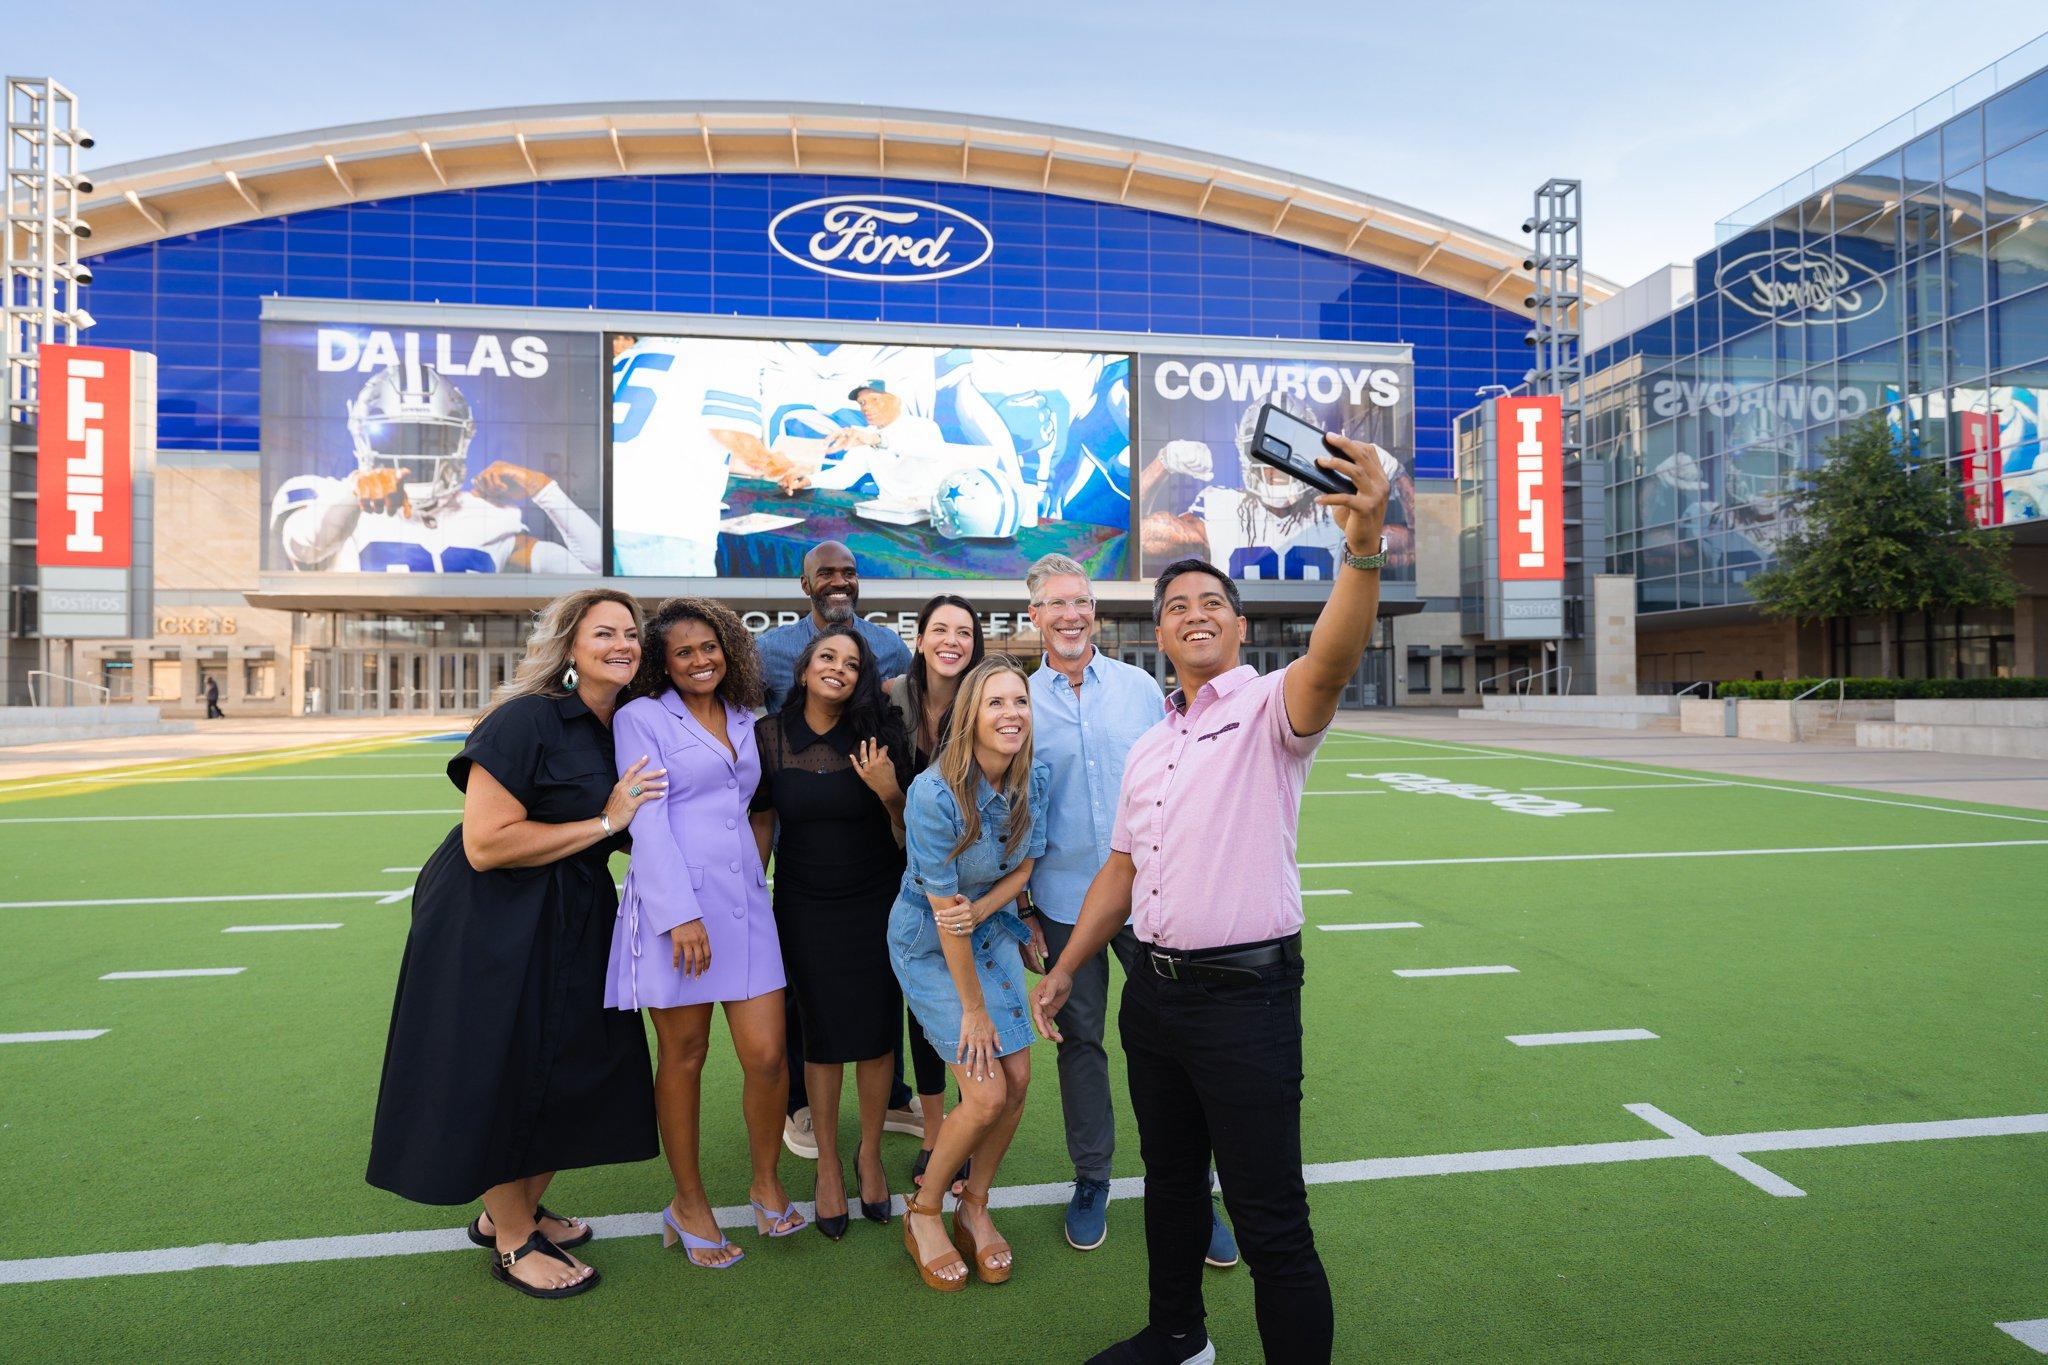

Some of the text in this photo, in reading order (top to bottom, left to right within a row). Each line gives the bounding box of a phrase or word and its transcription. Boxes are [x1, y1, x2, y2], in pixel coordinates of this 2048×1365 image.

[808, 204, 955, 268] Ford
[316, 328, 550, 379] DALLAS
[1154, 360, 1400, 406] COWBOYS
[66, 358, 105, 553] HILTI
[1516, 407, 1545, 568] HILTI
[155, 616, 237, 635] ICKETS
